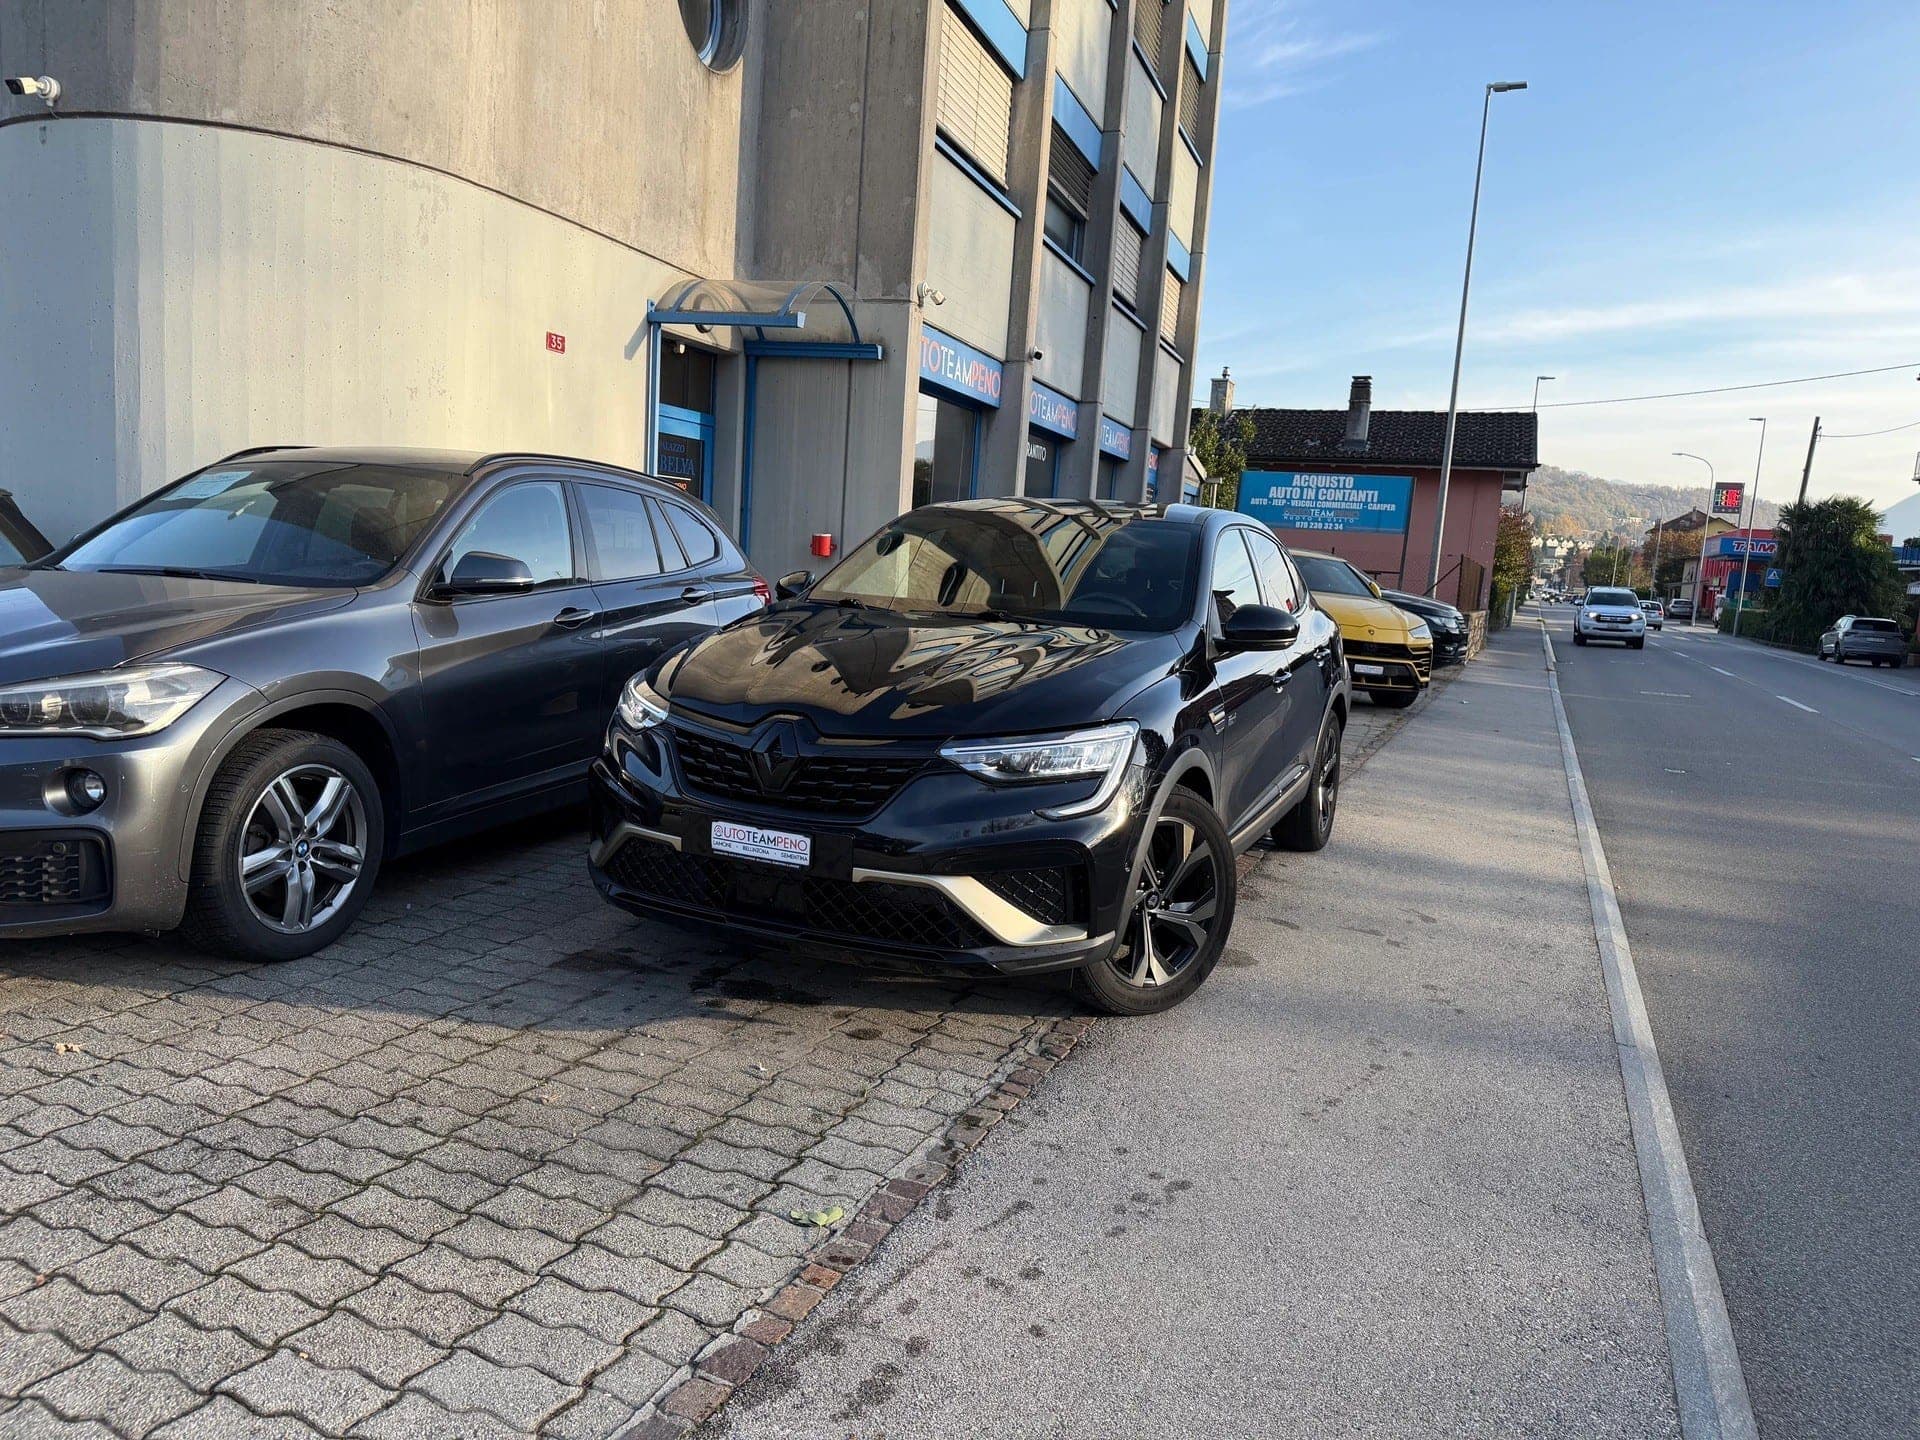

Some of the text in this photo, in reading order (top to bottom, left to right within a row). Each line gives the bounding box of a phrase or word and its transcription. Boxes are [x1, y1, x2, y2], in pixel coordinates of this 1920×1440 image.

[551, 334, 562, 350] 35
[1292, 474, 1354, 489] ACQUISTO
[1268, 486, 1379, 503] AUTO IN CONTANTI
[1271, 499, 1286, 507] JEEP
[1290, 500, 1316, 508] VEICOLI
[1316, 501, 1363, 510] COMMERCIALI
[1367, 503, 1396, 511] CAMPER
[742, 845, 770, 855] BELLINZONA
[781, 852, 808, 861] SEMENTINA
